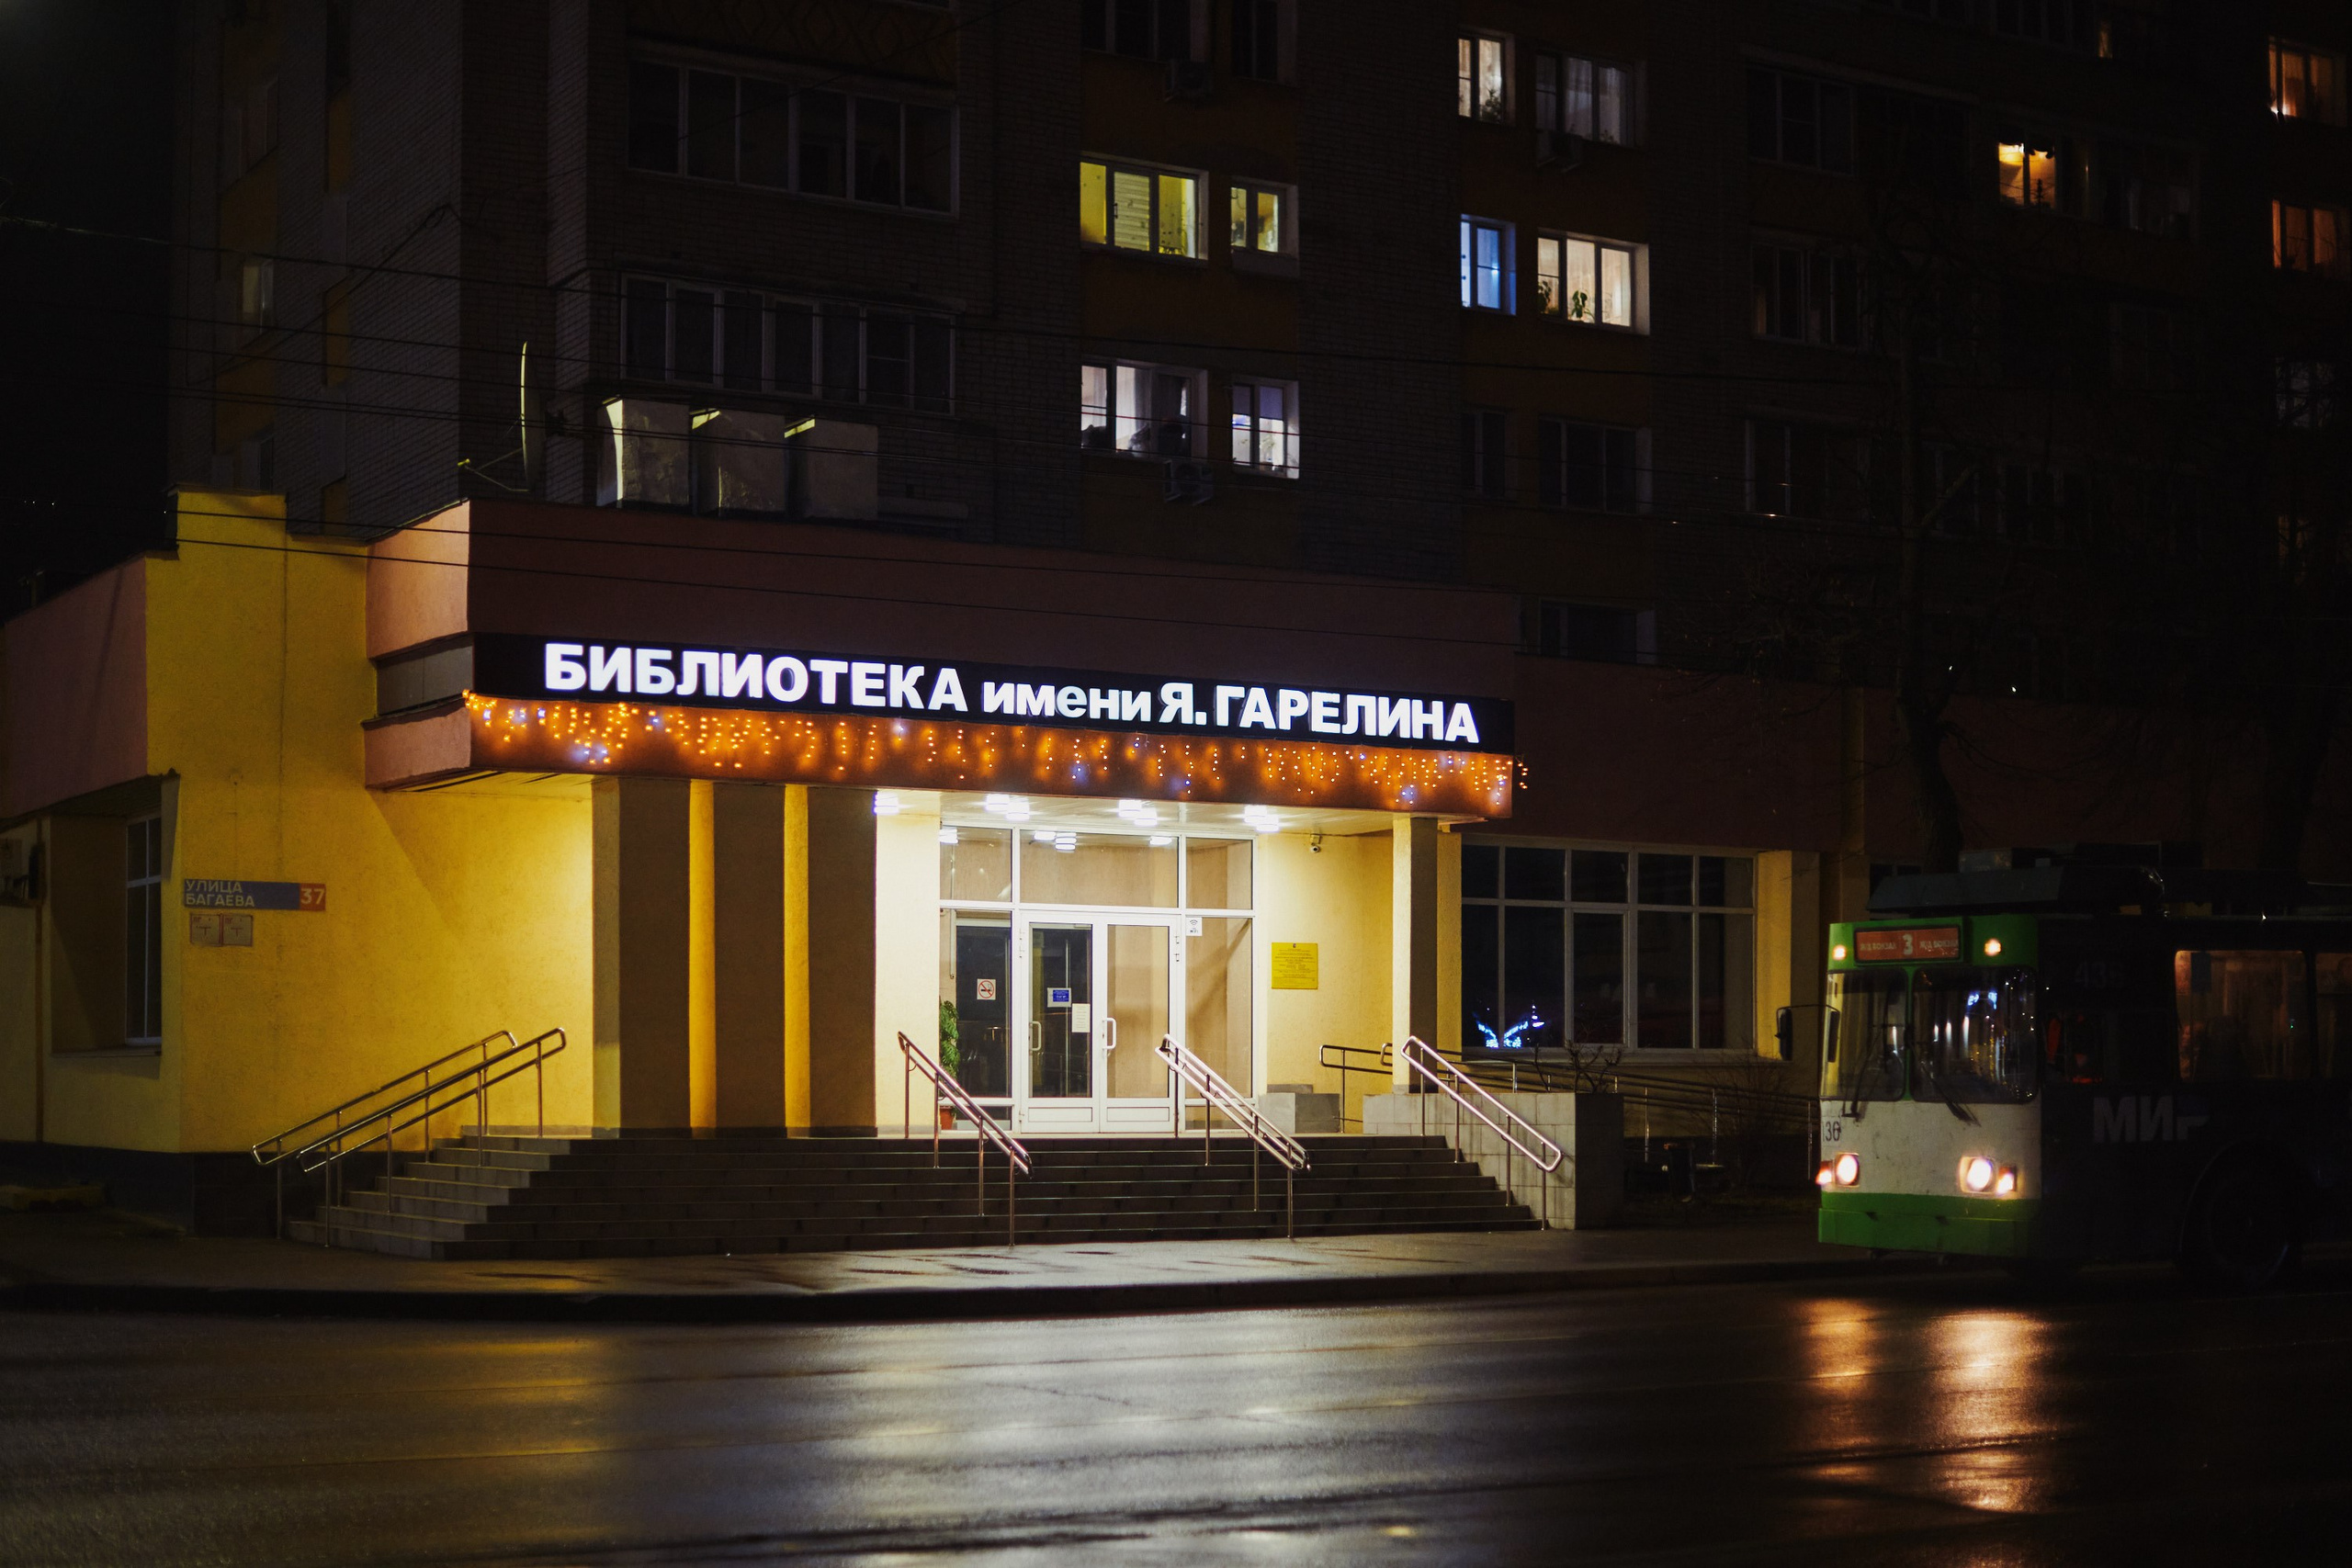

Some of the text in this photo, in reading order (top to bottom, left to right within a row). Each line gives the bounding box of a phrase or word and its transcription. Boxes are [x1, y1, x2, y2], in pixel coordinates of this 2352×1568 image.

[546, 642, 969, 712] БИБЛИОТЕКА
[982, 681, 1151, 723] имени
[1216, 683, 1480, 744] ГАРЕЛИНА
[186, 880, 243, 894] УЛИЦА
[300, 887, 325, 906] 37
[186, 893, 255, 908] БАГАЕВА
[1902, 933, 1914, 955] 3
